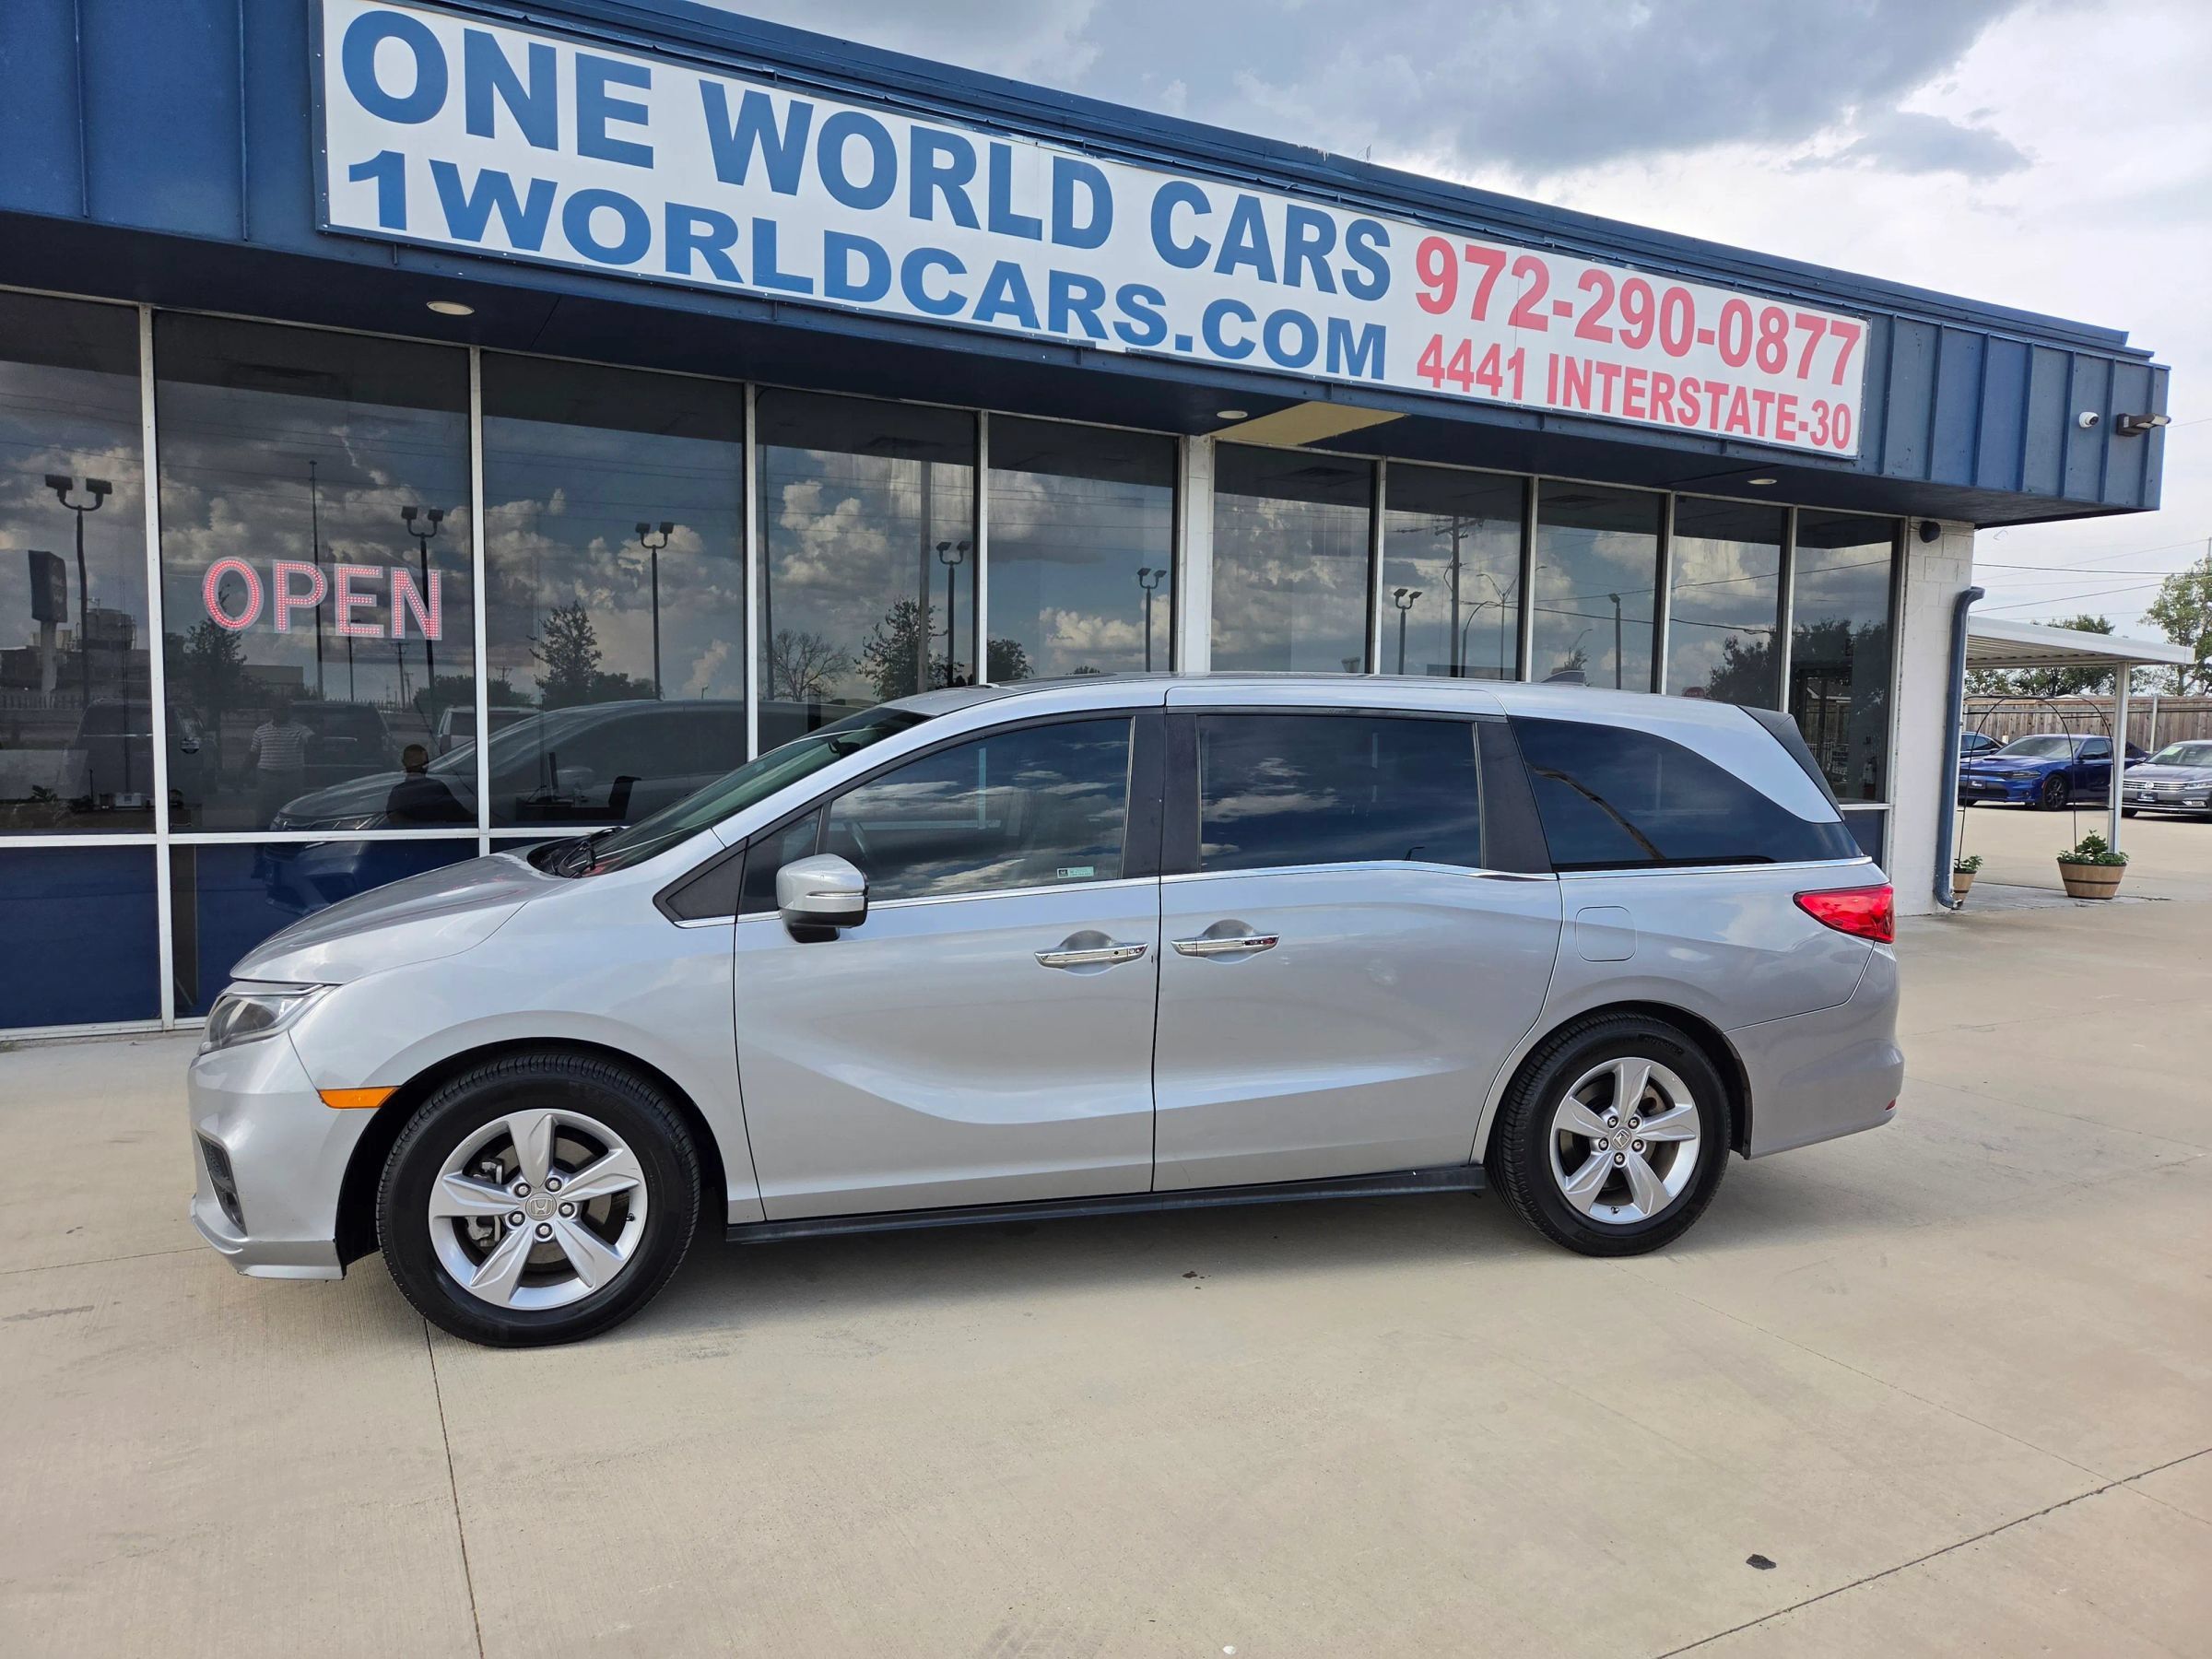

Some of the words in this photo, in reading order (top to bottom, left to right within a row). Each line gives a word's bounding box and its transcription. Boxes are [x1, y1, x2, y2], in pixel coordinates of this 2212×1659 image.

[341, 9, 654, 170] ONE
[699, 79, 1114, 251] WORLD
[1149, 181, 1392, 302] CARS
[347, 149, 1387, 382] 1WORLDCARS.COM
[1415, 236, 1862, 386] 972-290-0877
[1417, 334, 1526, 401] 4441
[1547, 353, 1853, 451] INTERSTATE-30
[203, 557, 442, 641] OPEN
